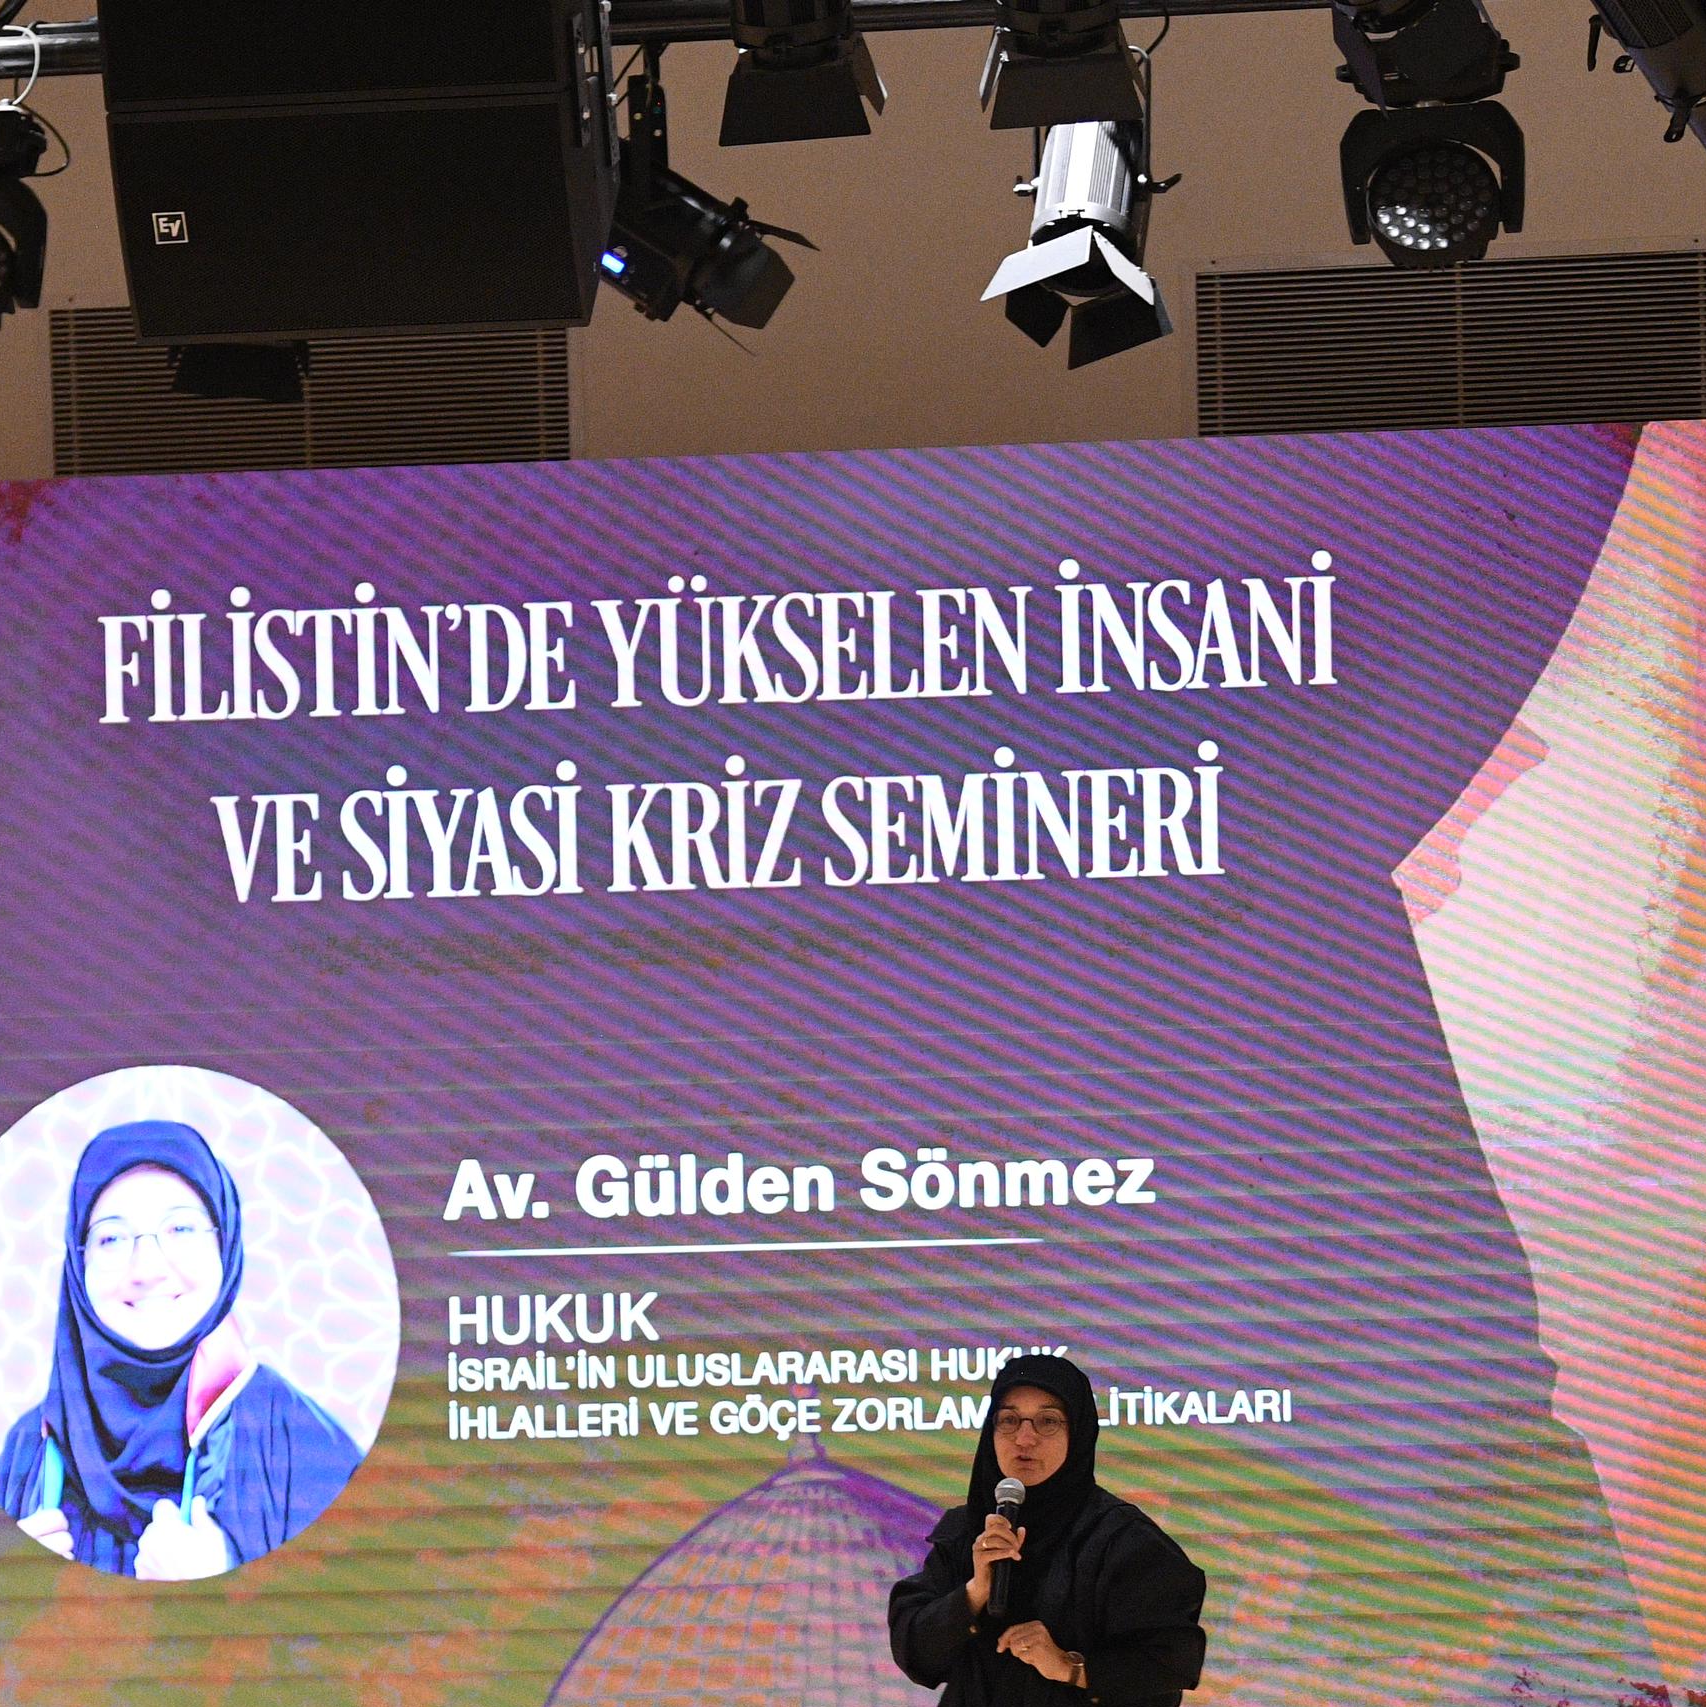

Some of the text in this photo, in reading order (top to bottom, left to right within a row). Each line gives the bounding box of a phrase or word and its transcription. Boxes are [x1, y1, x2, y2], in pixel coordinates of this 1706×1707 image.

[158, 217, 182, 237] EV
[97, 550, 1338, 723] FİLİSTİN'DE YÜKSELEN İNSANİ
[210, 740, 1225, 903] VE SİYASİ KRİZ SEMİNERİ
[442, 1147, 1156, 1221] Av. Gülden Sönmez
[448, 1291, 660, 1347] HUKUK
[447, 1345, 1069, 1393] İSRAİL'İN ULUSLARARASI HUK
[448, 1396, 639, 1441] İHLALLERİ
[648, 1401, 699, 1436] VE
[709, 1393, 822, 1441] GÖÇE
[831, 1395, 992, 1432] ZORLAM
